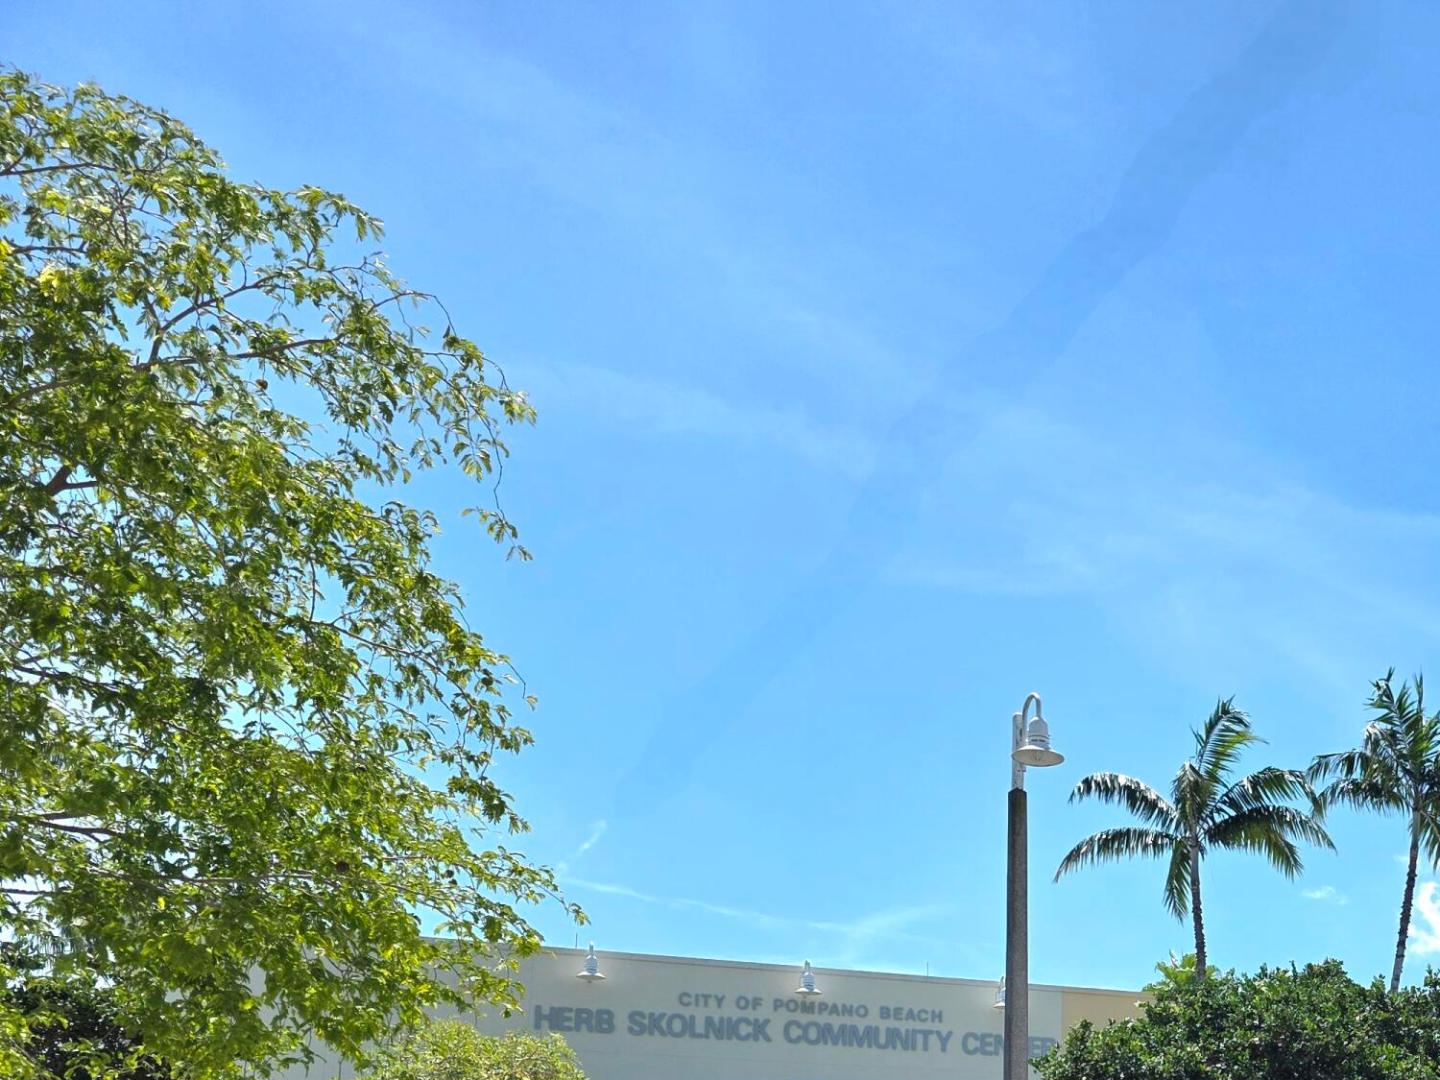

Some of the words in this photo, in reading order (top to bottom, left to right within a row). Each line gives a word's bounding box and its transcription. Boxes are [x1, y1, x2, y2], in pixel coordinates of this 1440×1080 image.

[678, 992, 726, 1010] CITY
[735, 996, 764, 1011] OF
[773, 999, 869, 1019] POMPANO
[879, 1006, 943, 1024] BEACH
[534, 1005, 615, 1034] HERB
[627, 1010, 772, 1043] SKOLNICK
[783, 1020, 953, 1053] COMMUNITY
